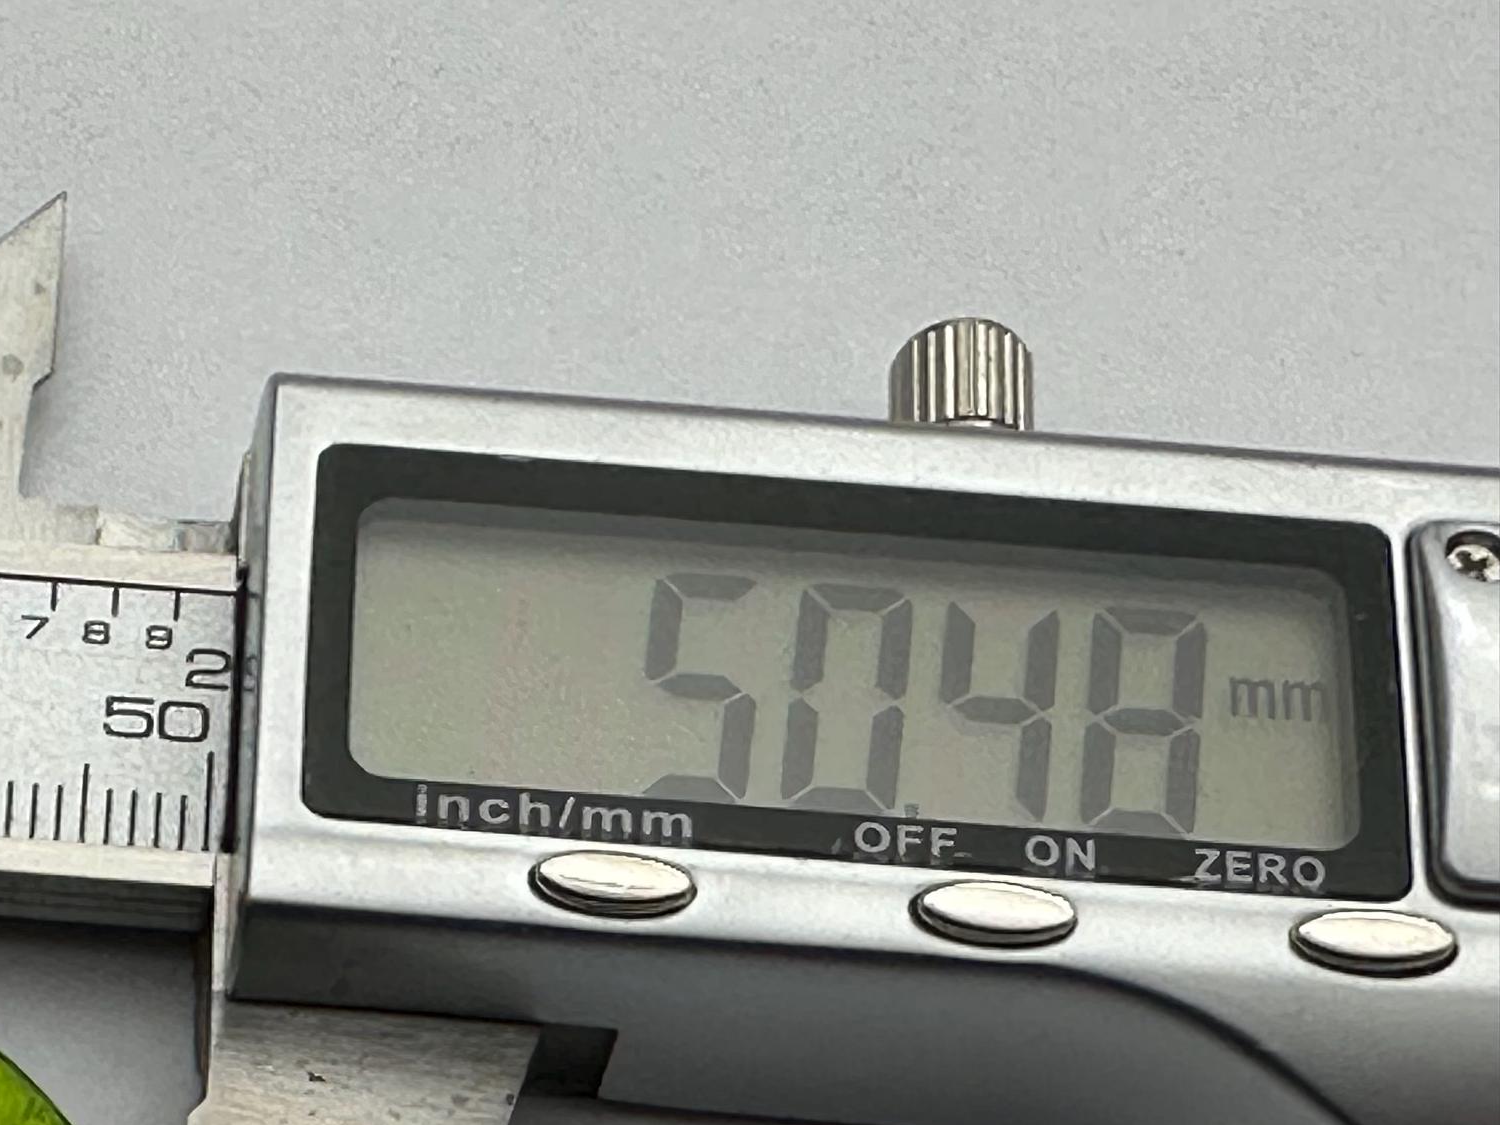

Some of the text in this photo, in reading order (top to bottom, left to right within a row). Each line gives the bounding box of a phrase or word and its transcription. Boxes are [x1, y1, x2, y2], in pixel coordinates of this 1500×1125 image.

[21, 615, 50, 640] 7
[82, 620, 111, 645] 8
[145, 625, 173, 650] 9
[184, 648, 232, 691] 2
[103, 695, 211, 743] 50
[1228, 675, 1328, 723] mm
[414, 783, 695, 840] inch/mm
[854, 820, 958, 860] OFF
[1025, 833, 1097, 875] ON
[1194, 847, 1328, 891] ZERO
